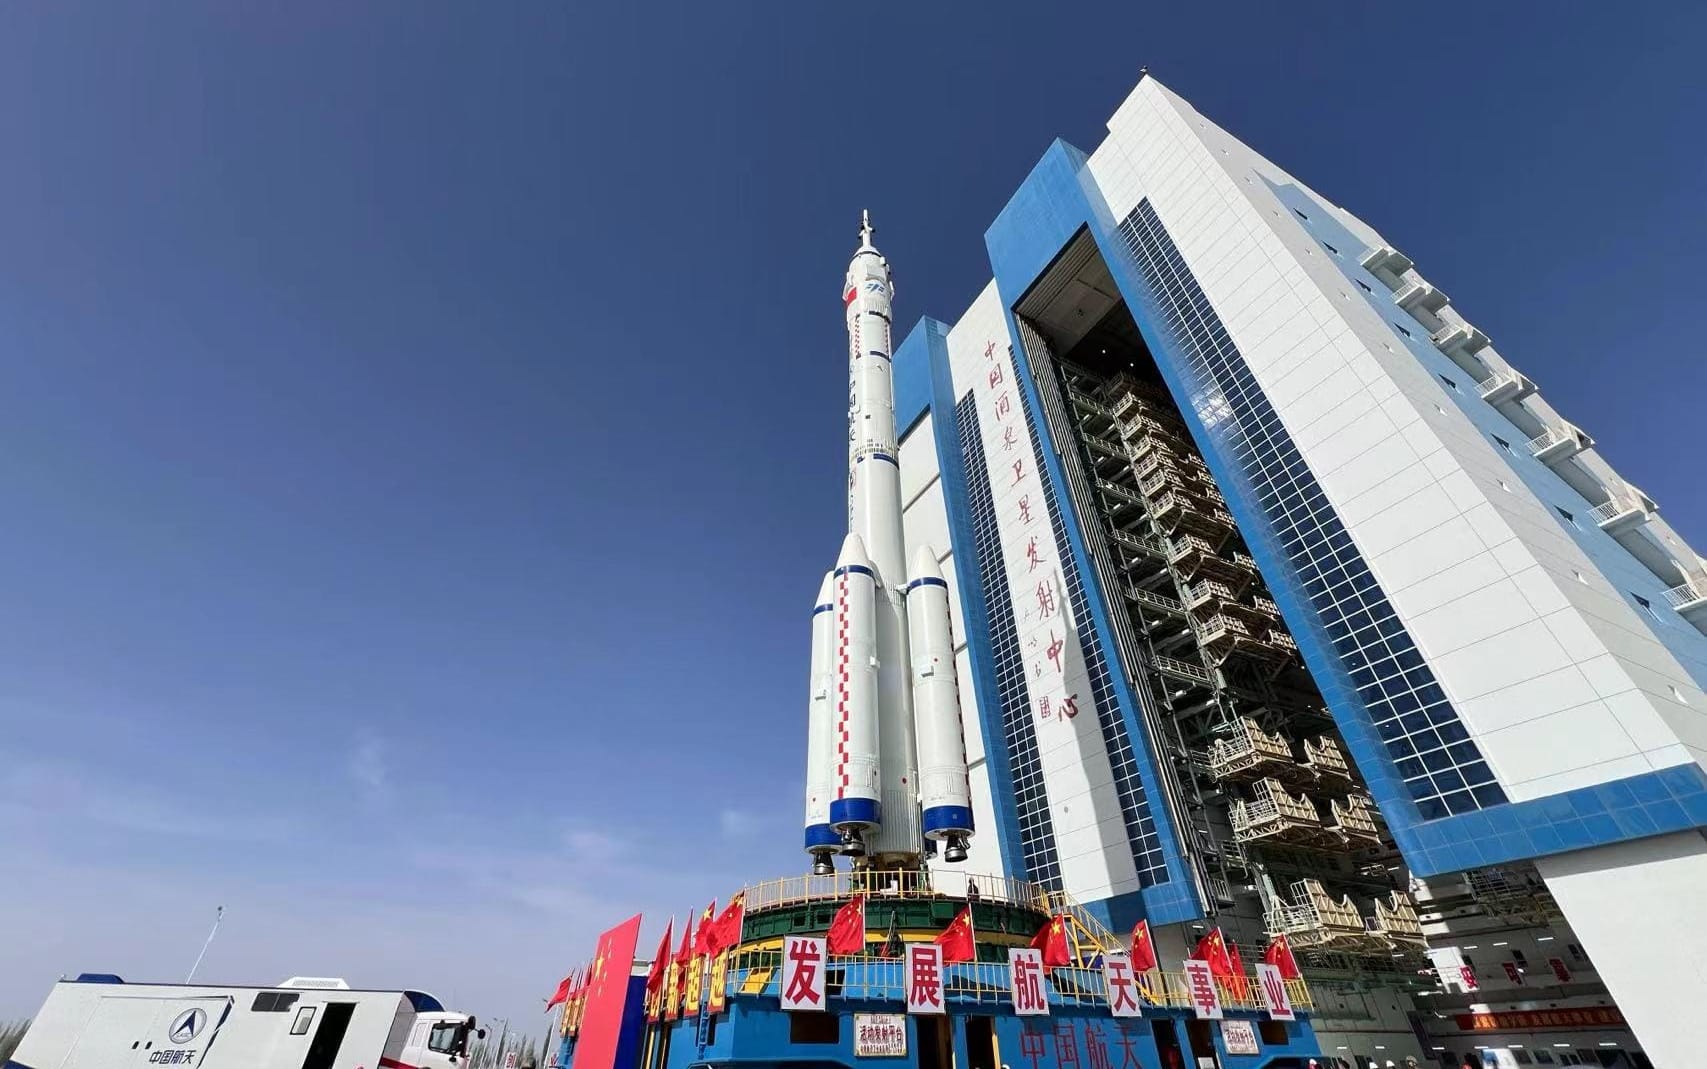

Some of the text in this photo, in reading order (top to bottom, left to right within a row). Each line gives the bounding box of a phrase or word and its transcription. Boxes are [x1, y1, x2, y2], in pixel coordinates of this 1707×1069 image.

[984, 341, 1078, 721] 中国酒泉卫星发射中心
[785, 940, 1291, 1015] 发展航天事业
[149, 1049, 197, 1064] 中国航天
